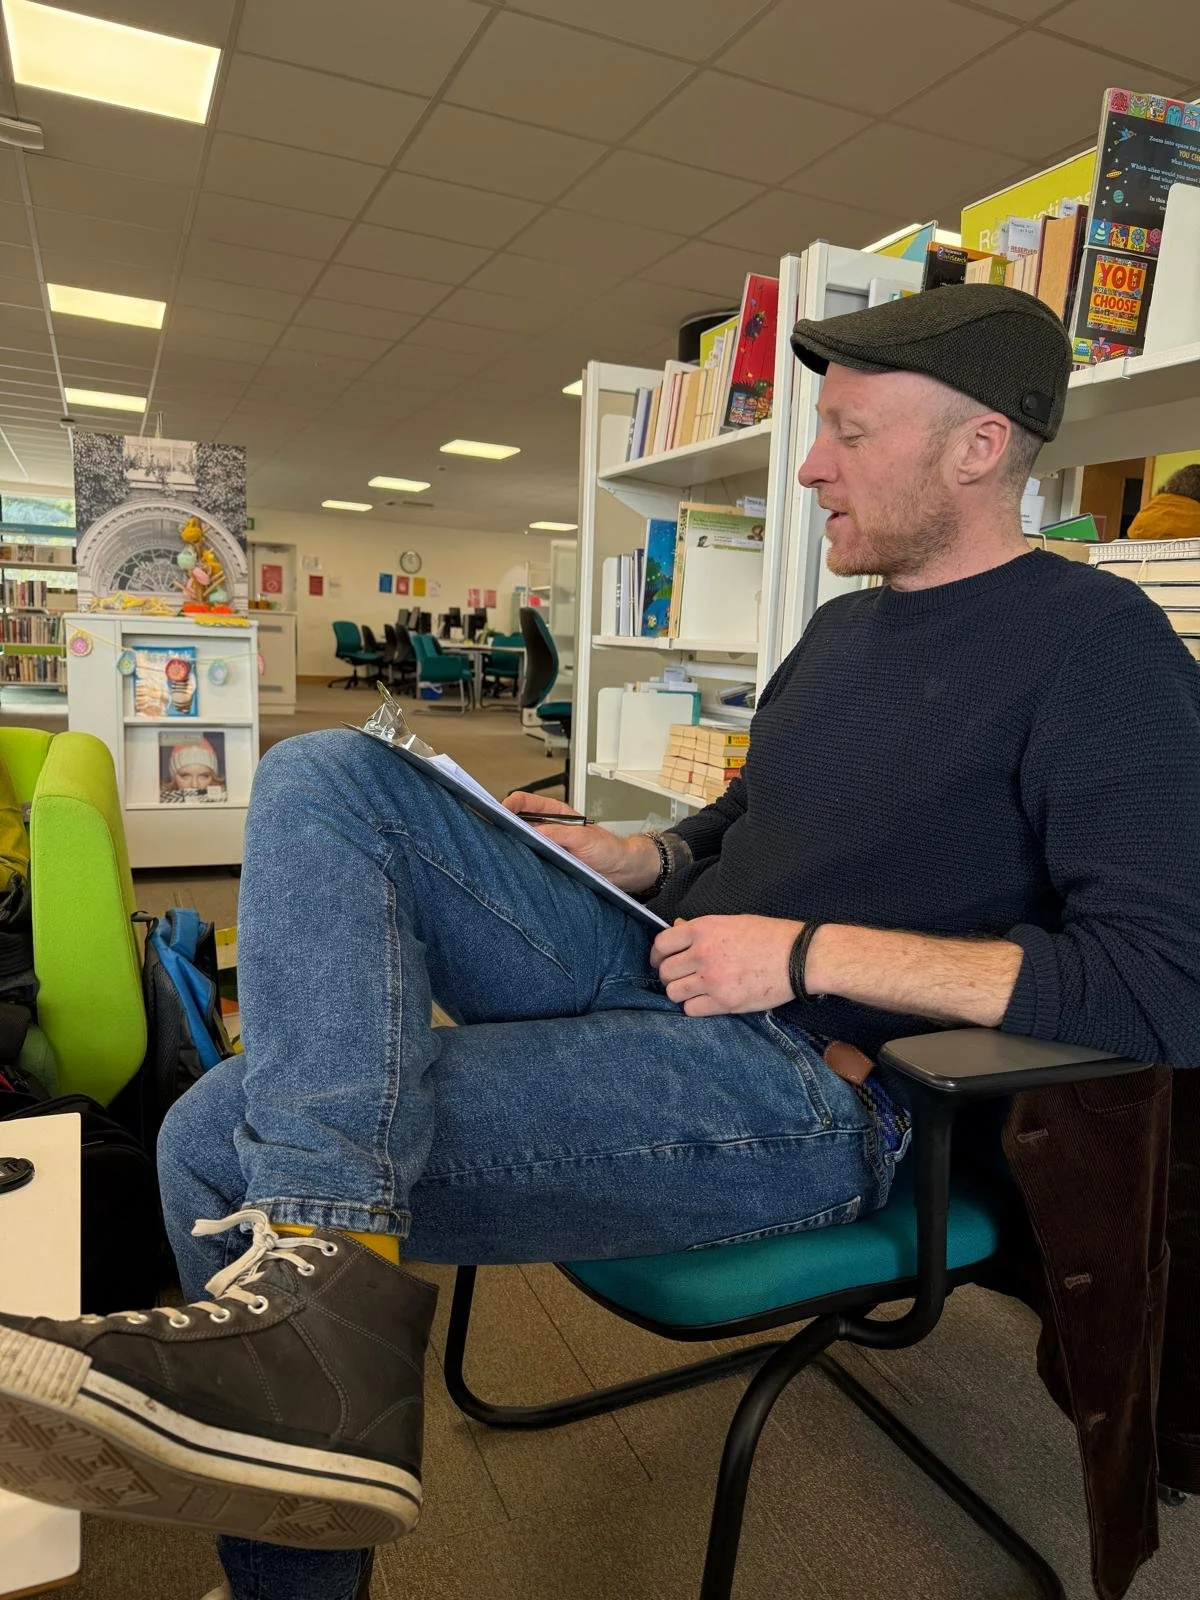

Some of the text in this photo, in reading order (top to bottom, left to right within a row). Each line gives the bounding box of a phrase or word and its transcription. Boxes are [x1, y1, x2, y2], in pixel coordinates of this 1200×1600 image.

[1178, 150, 1190, 159] YOU
[1131, 163, 1147, 171] Which
[1010, 245, 1038, 256] RESERVED
[1099, 262, 1143, 292] YOU
[1093, 293, 1138, 313] CHOOSE
